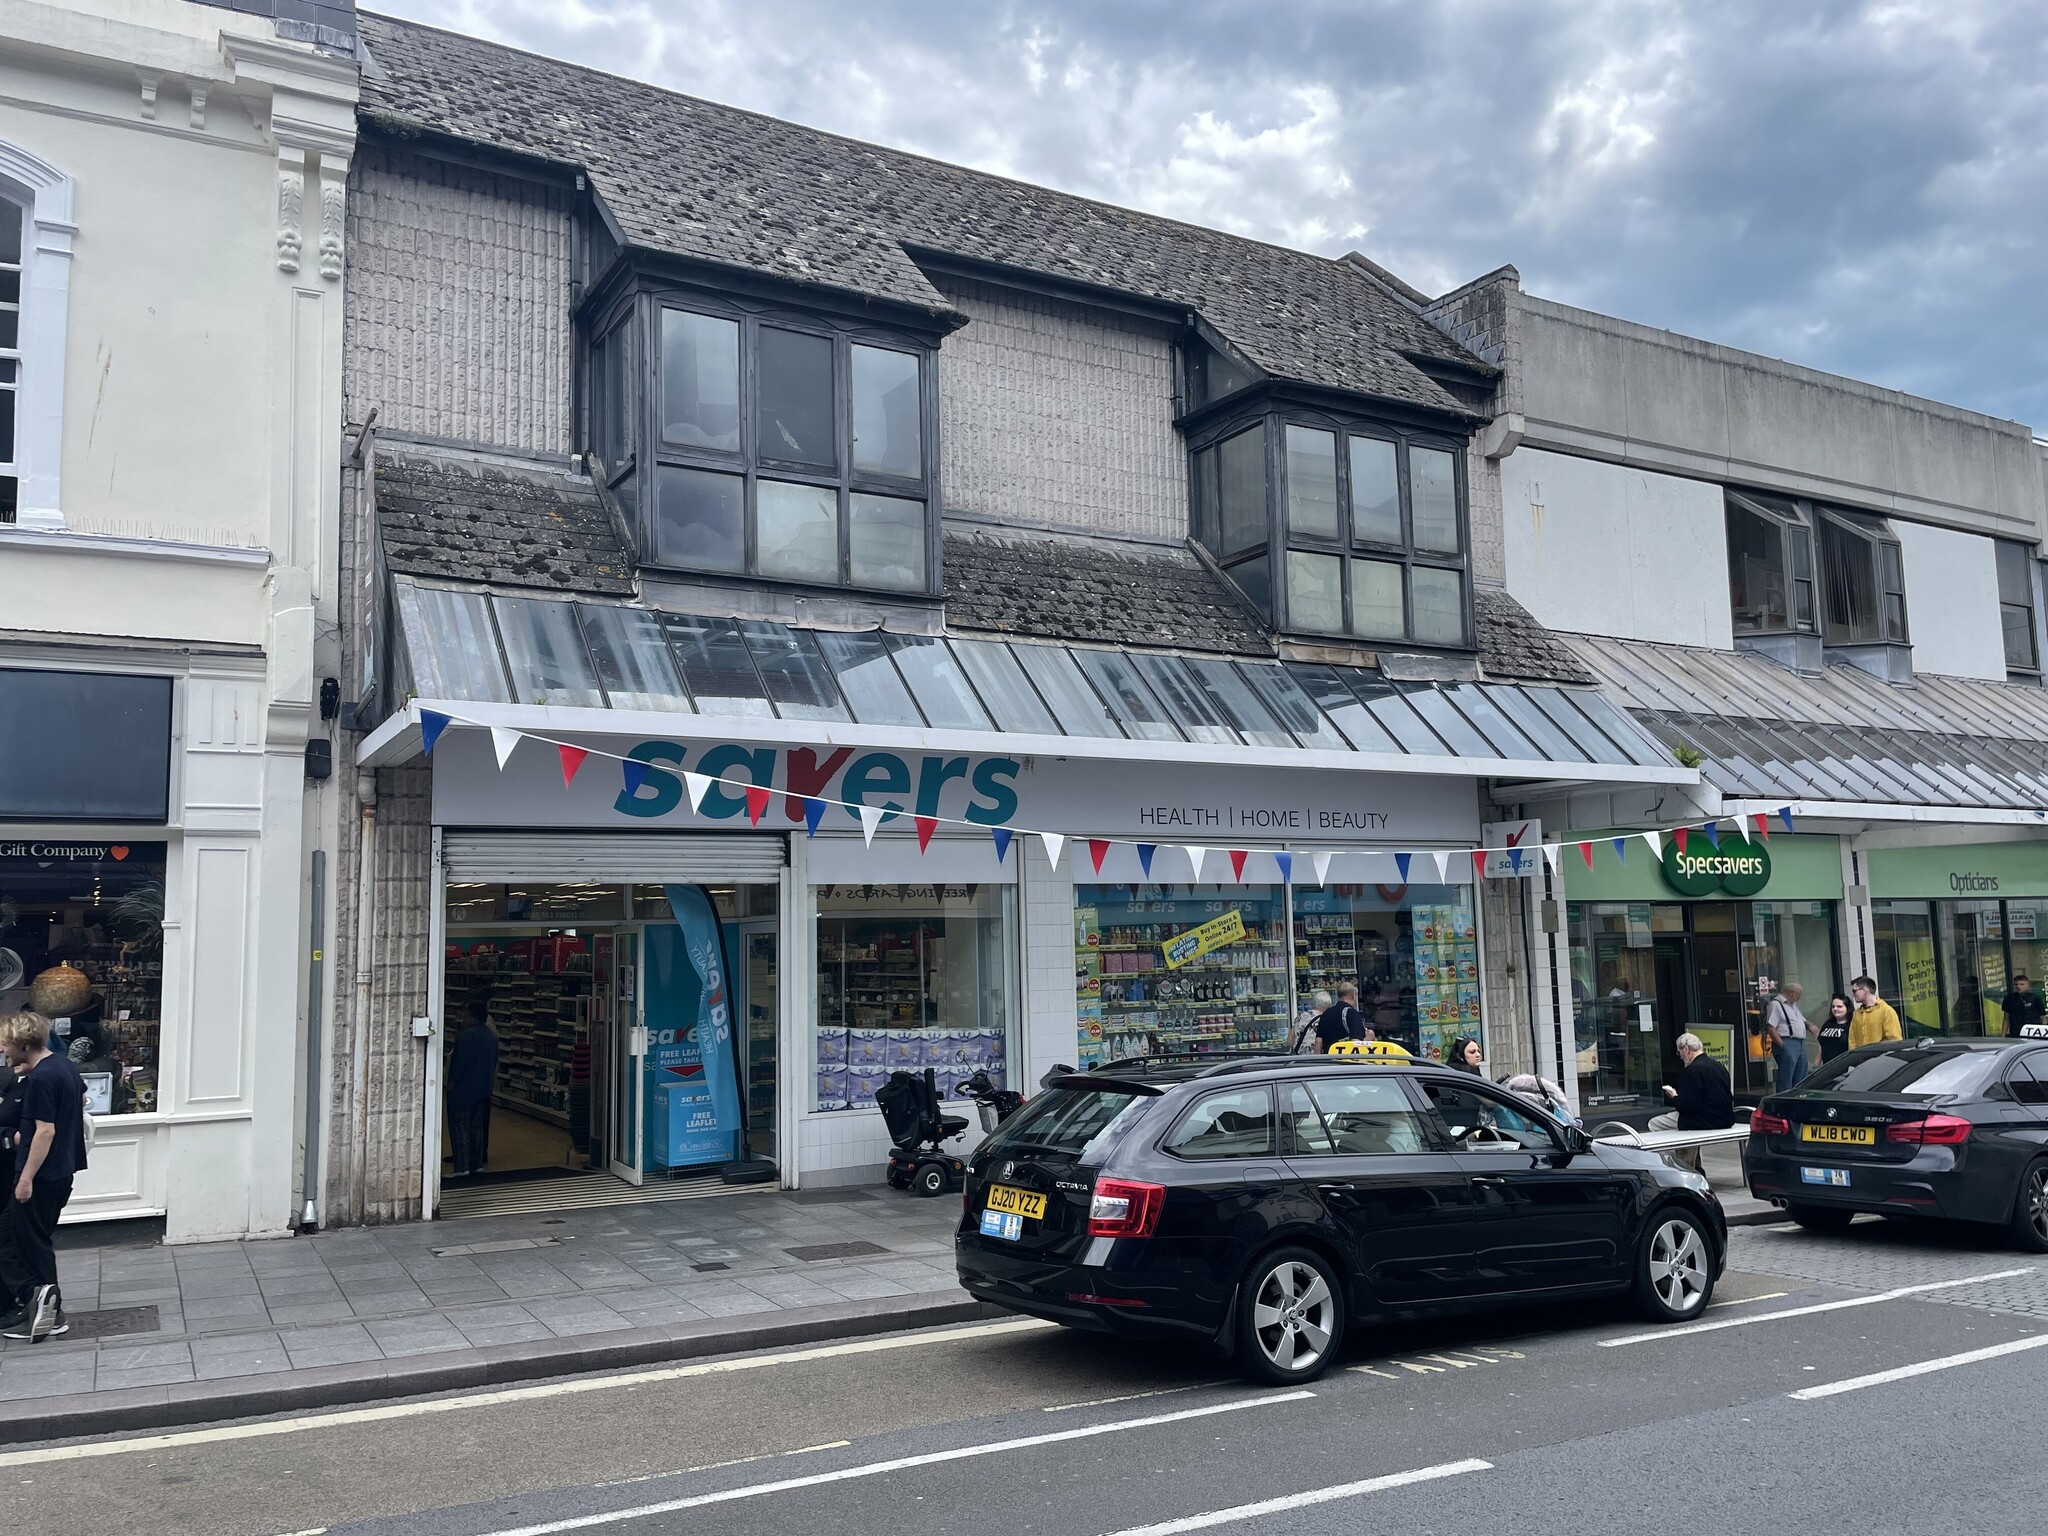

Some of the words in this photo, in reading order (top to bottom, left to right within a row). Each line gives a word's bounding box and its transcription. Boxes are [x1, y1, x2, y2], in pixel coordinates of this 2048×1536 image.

[613, 741, 1020, 825] savers
[1141, 807, 1219, 826] HEALTH
[1241, 810, 1300, 828] HOME
[1319, 811, 1389, 830] BEAUTY
[0, 843, 28, 857] Gift
[31, 843, 108, 861] Company
[1498, 859, 1533, 869] saers
[1676, 851, 1763, 880] Specsavers
[1949, 871, 1999, 896] Opticians
[1126, 900, 1176, 913] savers
[1204, 932, 1222, 942] Online
[1222, 922, 1237, 934] 24/7
[1905, 961, 1919, 970] For
[1908, 968, 1931, 982] pairs?
[647, 1022, 699, 1046] save
[660, 1050, 680, 1059] FREE
[682, 1048, 701, 1057] LEAF
[1335, 1047, 1388, 1058] TAXI
[660, 1058, 682, 1066] PLEASE
[692, 1111, 711, 1120] FREE
[1810, 1126, 1838, 1140] WL18
[1841, 1127, 1866, 1141] CWO
[1056, 1180, 1088, 1191] OCTAVIA
[991, 1187, 1014, 1209] GJ20
[1017, 1192, 1041, 1214] YZZ
